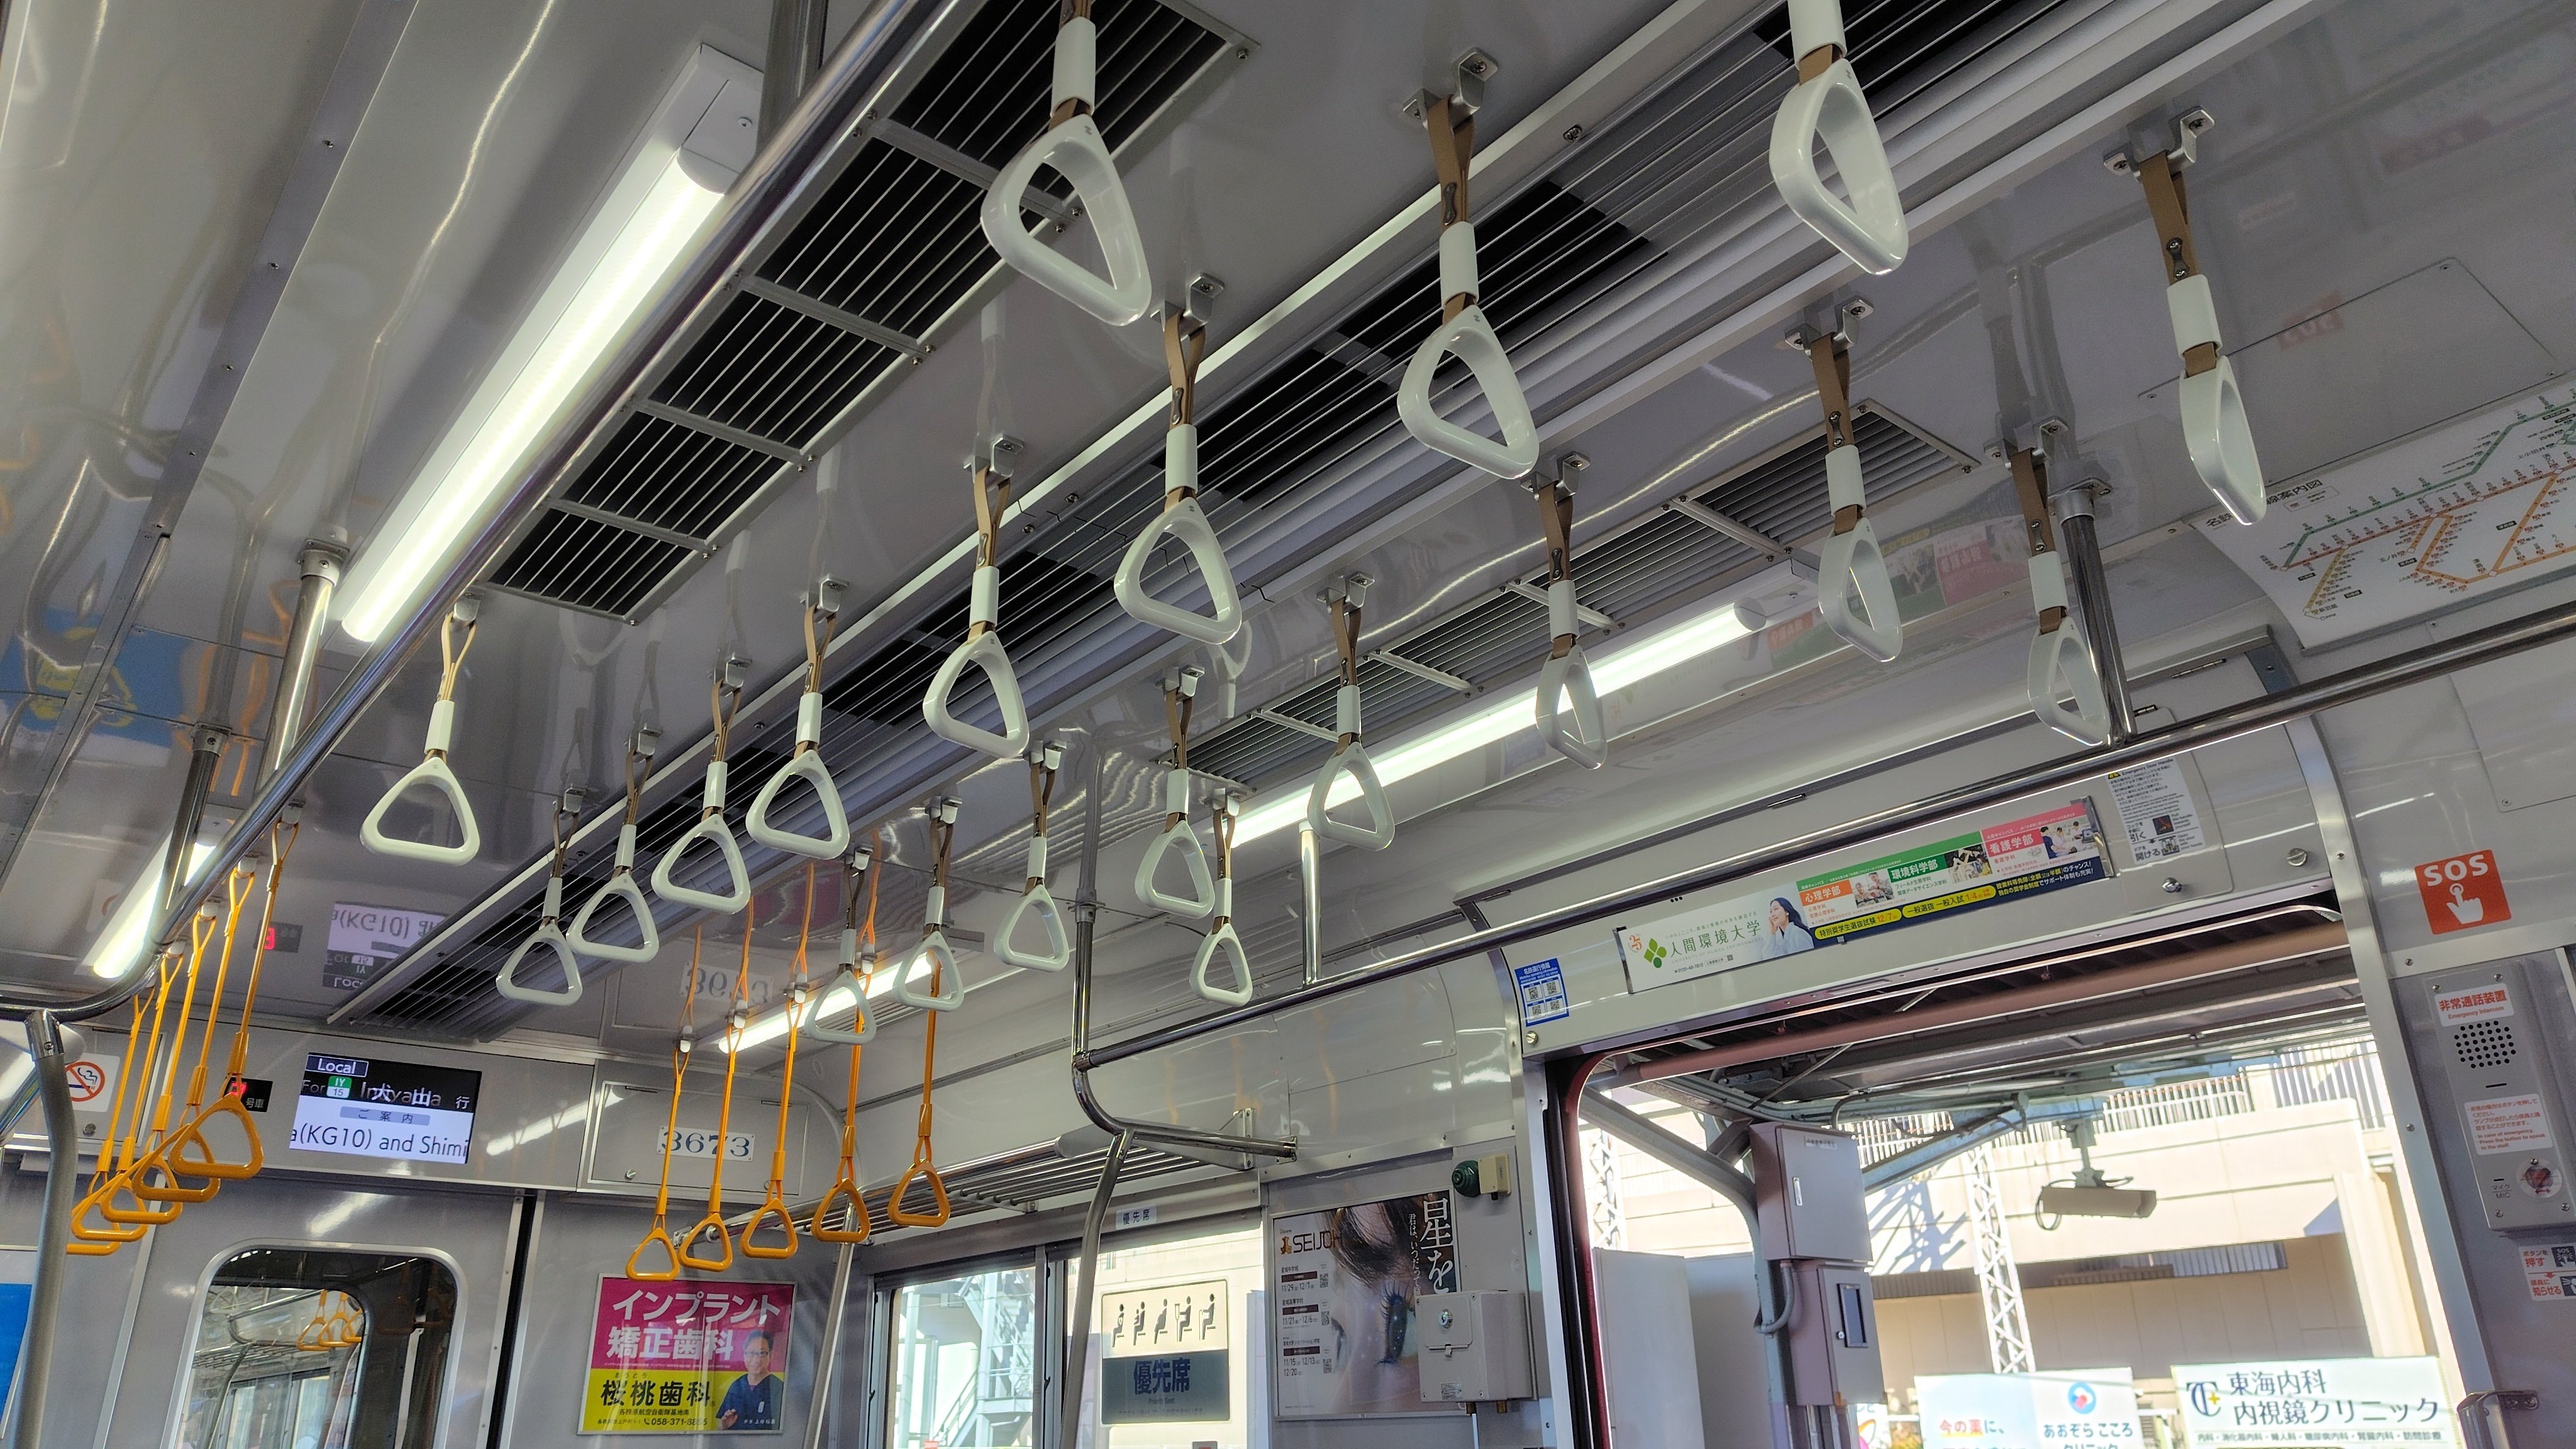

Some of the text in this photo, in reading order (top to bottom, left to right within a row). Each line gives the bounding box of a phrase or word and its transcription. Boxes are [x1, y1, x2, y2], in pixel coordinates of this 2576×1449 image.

[1989, 833, 2034, 854] 看護学部
[2129, 831, 2146, 842] 引く
[2135, 848, 2160, 862] 開ける
[1890, 859, 1938, 880] 環境科学部
[2424, 854, 2489, 887] SOS
[1805, 886, 1841, 903] 心理学部
[1670, 919, 1762, 958] 人間環境大学
[2438, 989, 2507, 1011] 非常通話装置
[2448, 1006, 2504, 1020] Emergency Intercom
[318, 1058, 356, 1074] Local
[302, 1079, 325, 1094] For
[335, 1077, 345, 1086] IY
[246, 1097, 265, 1109] 号車
[455, 1096, 470, 1109] 行
[358, 1109, 414, 1124] ご案内
[379, 1134, 415, 1152] and
[662, 1131, 750, 1157] 3673
[1123, 1209, 1150, 1225] 優先席
[1293, 1230, 1342, 1253] SEIJOH
[1420, 1197, 1453, 1294] 星を
[2524, 1257, 2545, 1267] 押す
[2533, 1286, 2562, 1296] 知らせる
[613, 1289, 780, 1325] インプラント
[606, 1326, 733, 1360] 矯正歯科
[1133, 1357, 1191, 1395] 優先席
[2226, 1368, 2326, 1396] 東海内科
[601, 1379, 711, 1407] 桜桃歯科
[2234, 1397, 2438, 1426] 内視鏡クリニック
[1940, 1419, 2004, 1435] 今の薬に、
[2044, 1423, 2134, 1439] あおぞら こころ
